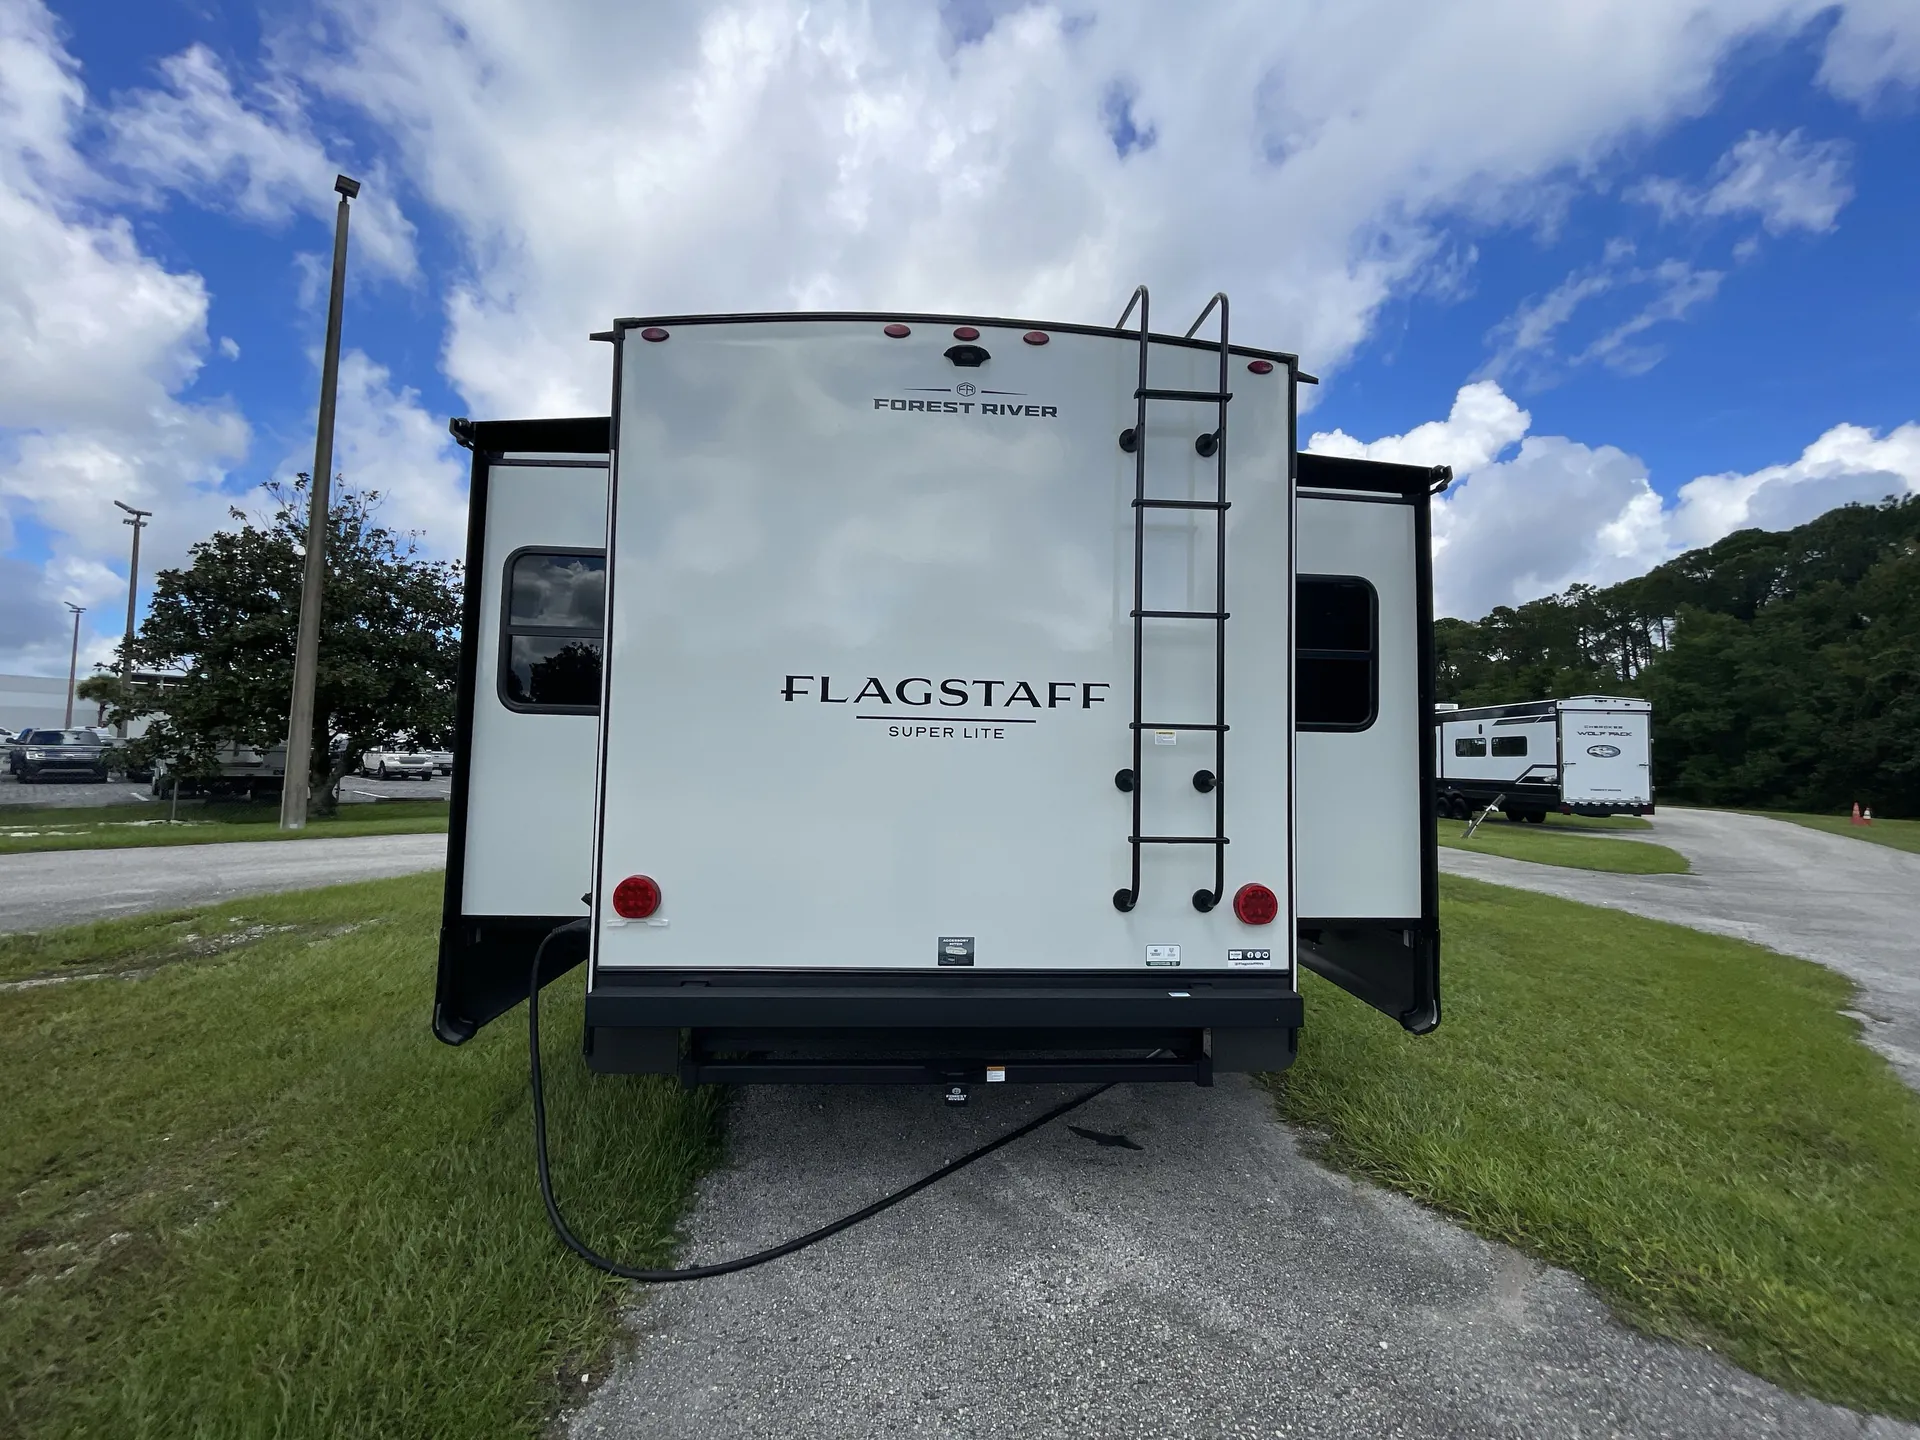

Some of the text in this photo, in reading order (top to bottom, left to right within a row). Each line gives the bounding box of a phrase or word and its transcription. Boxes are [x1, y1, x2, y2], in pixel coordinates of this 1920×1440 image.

[873, 398, 1058, 418] FOREST RIVER
[780, 674, 1111, 709] FLAGSTAFF
[888, 725, 1005, 740] SUPER LITE
